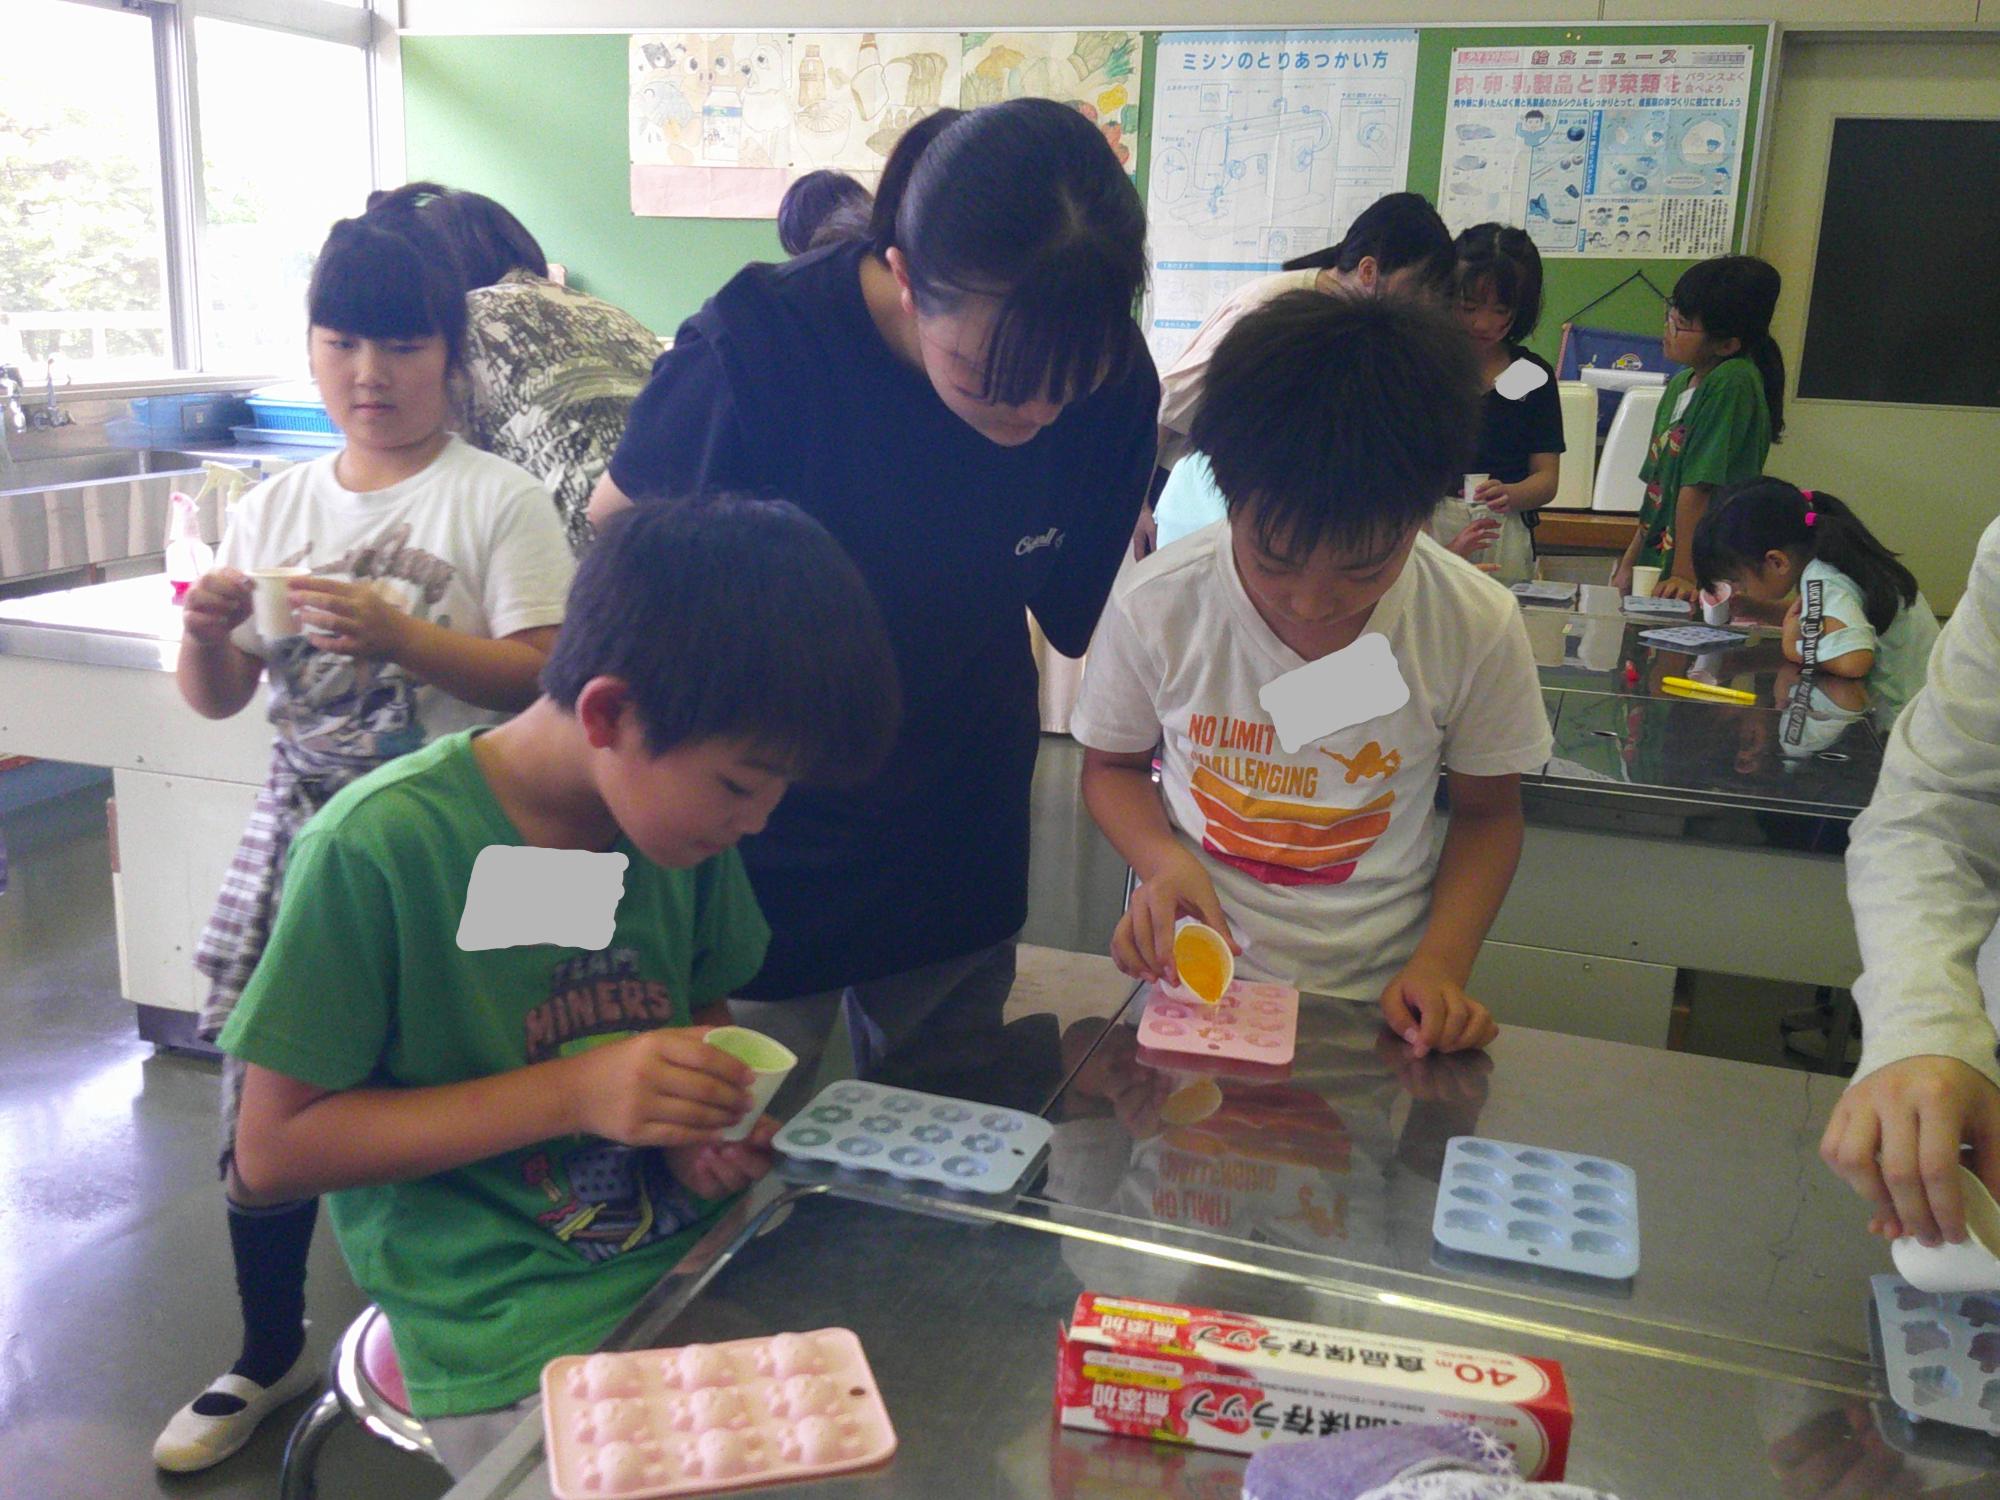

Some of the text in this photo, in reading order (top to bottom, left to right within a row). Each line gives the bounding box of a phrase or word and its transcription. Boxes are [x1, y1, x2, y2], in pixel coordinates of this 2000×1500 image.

[1182, 50, 1389, 71] ミシンのとりあつかい方
[1531, 49, 1677, 65] 給食ニュース
[1188, 713, 1276, 755] NO LIMIT
[1190, 750, 1319, 798] ALLENGING
[526, 980, 674, 1058] MINERS
[1192, 1325, 1426, 1373] 食品保存ラップ
[1092, 1383, 1171, 1418] 無添加
[1184, 1389, 1403, 1437] 保存ラップ
